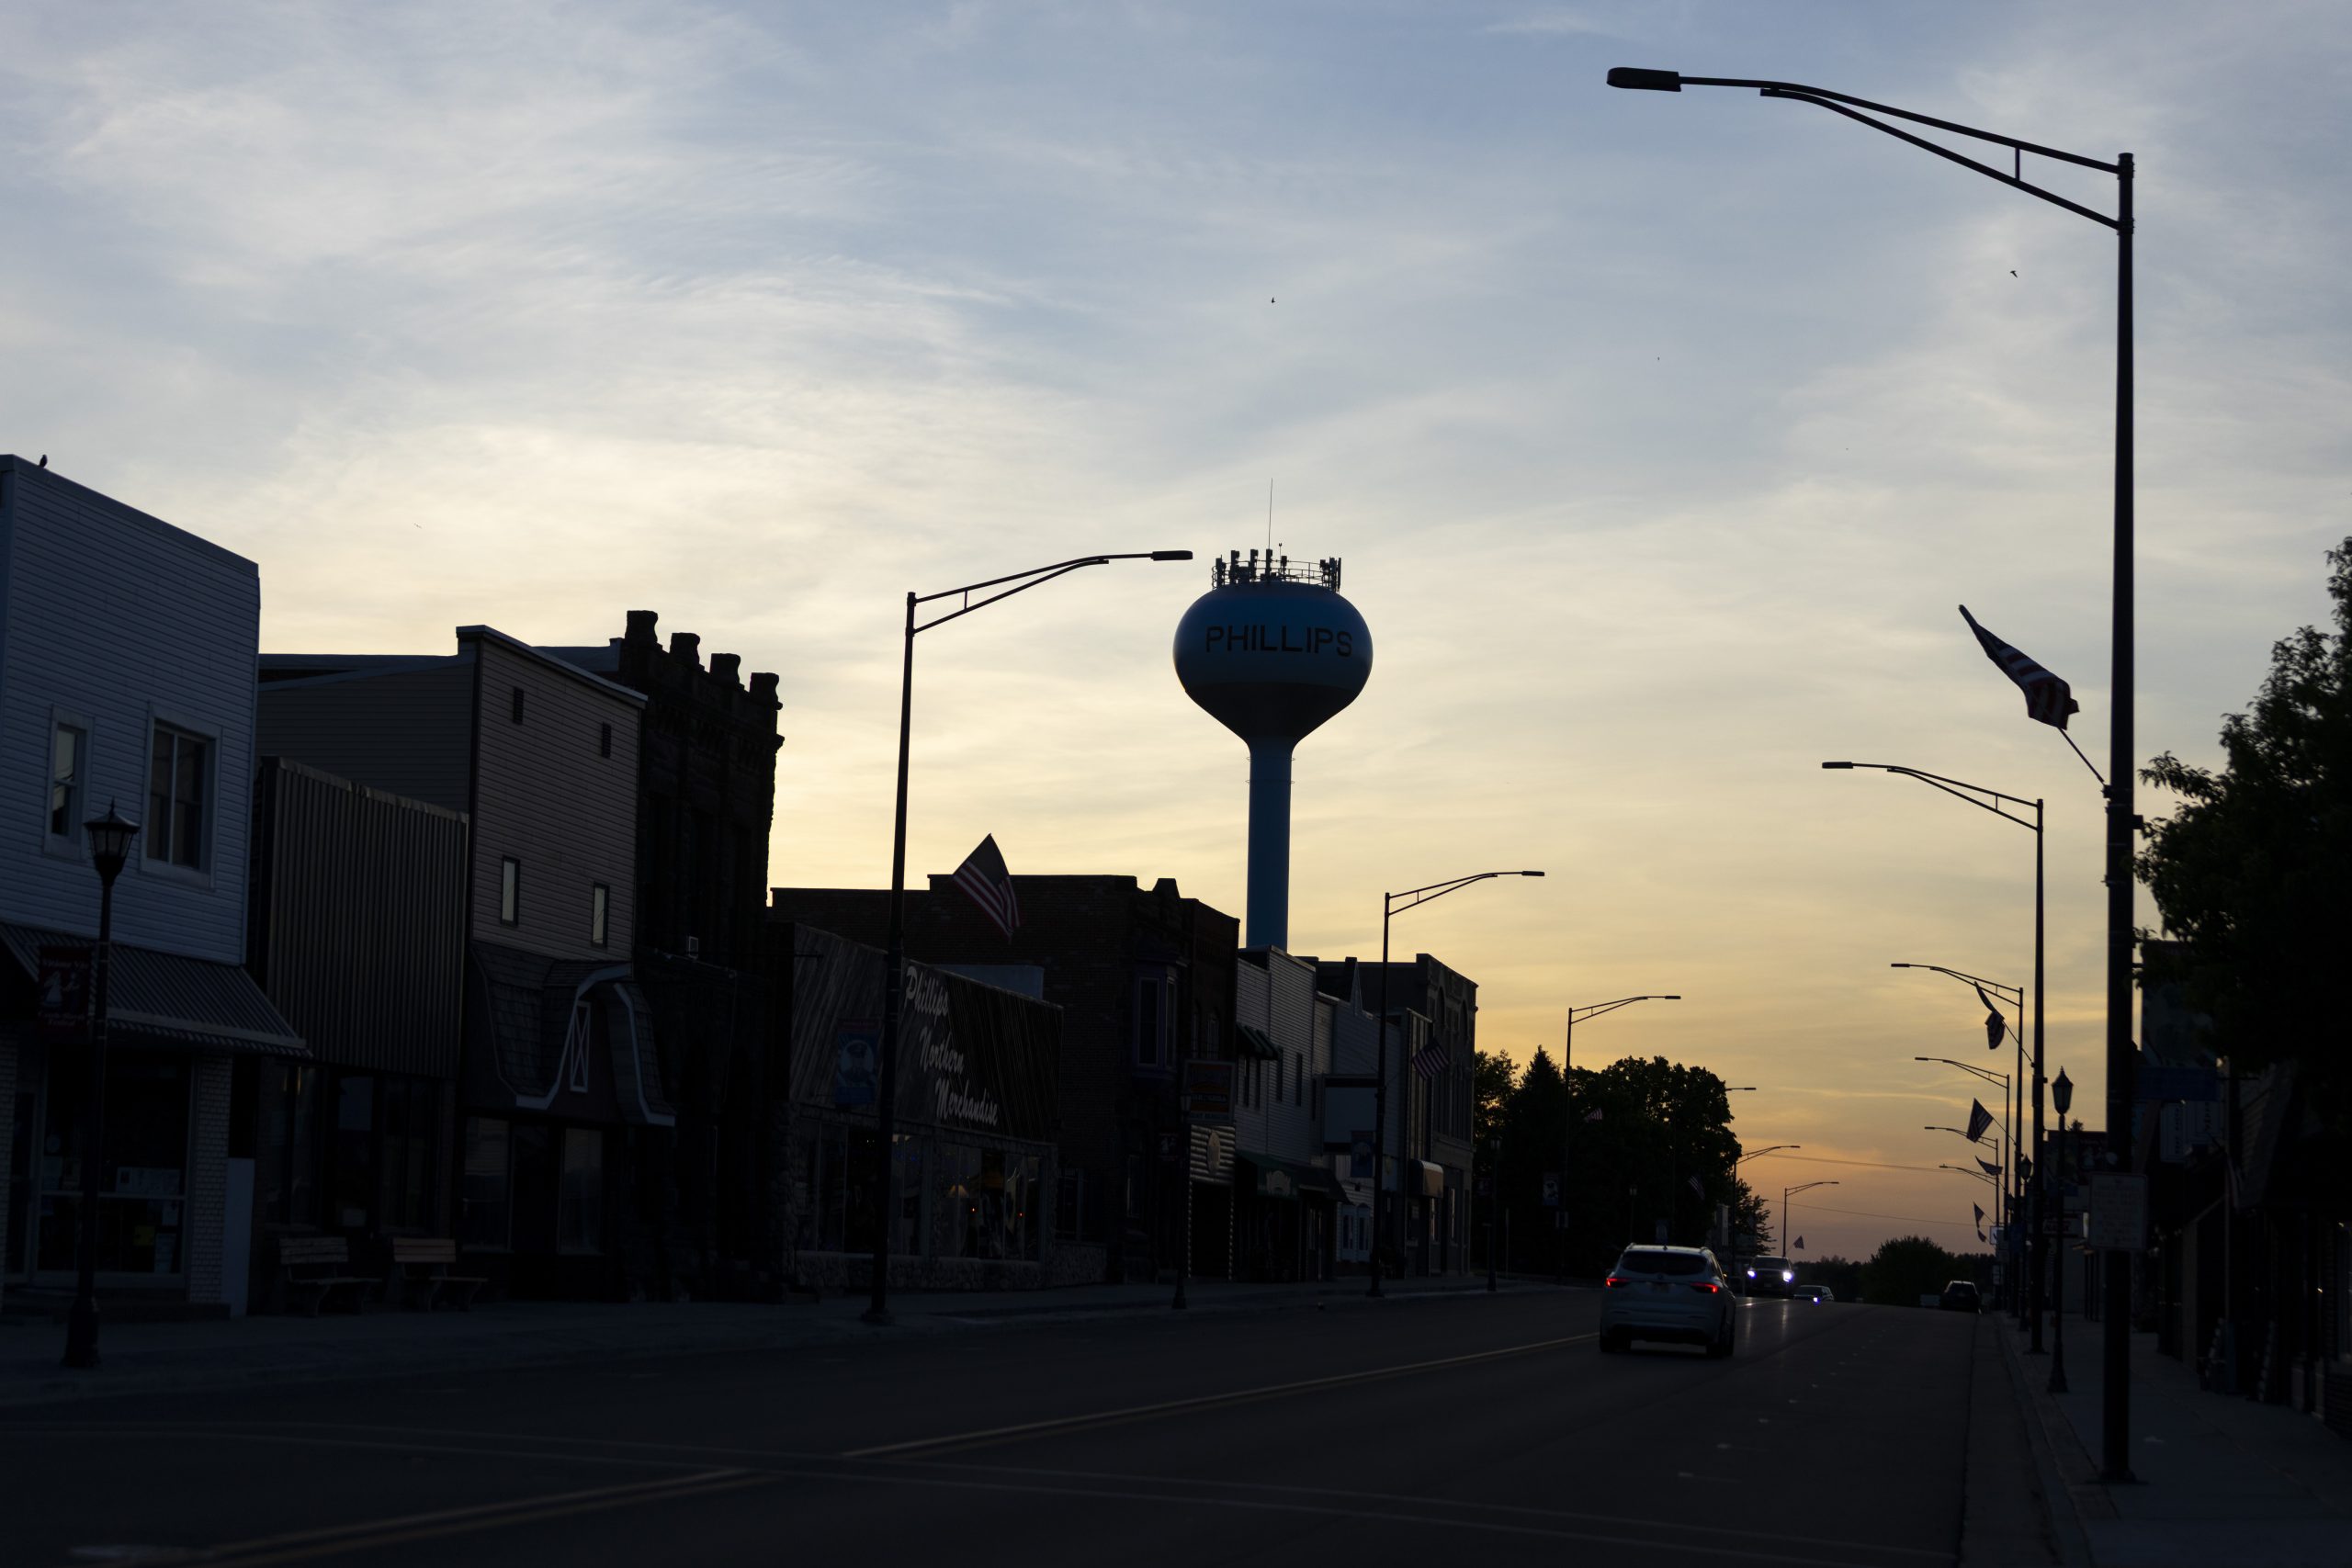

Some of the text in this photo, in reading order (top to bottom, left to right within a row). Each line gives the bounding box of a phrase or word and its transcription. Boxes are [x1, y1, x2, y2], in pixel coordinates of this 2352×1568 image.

[1205, 625, 1352, 658] PHILLIPS
[904, 965, 949, 1027] Phillips
[919, 1026, 965, 1076] Northern
[934, 1077, 1000, 1128] Merchandise
